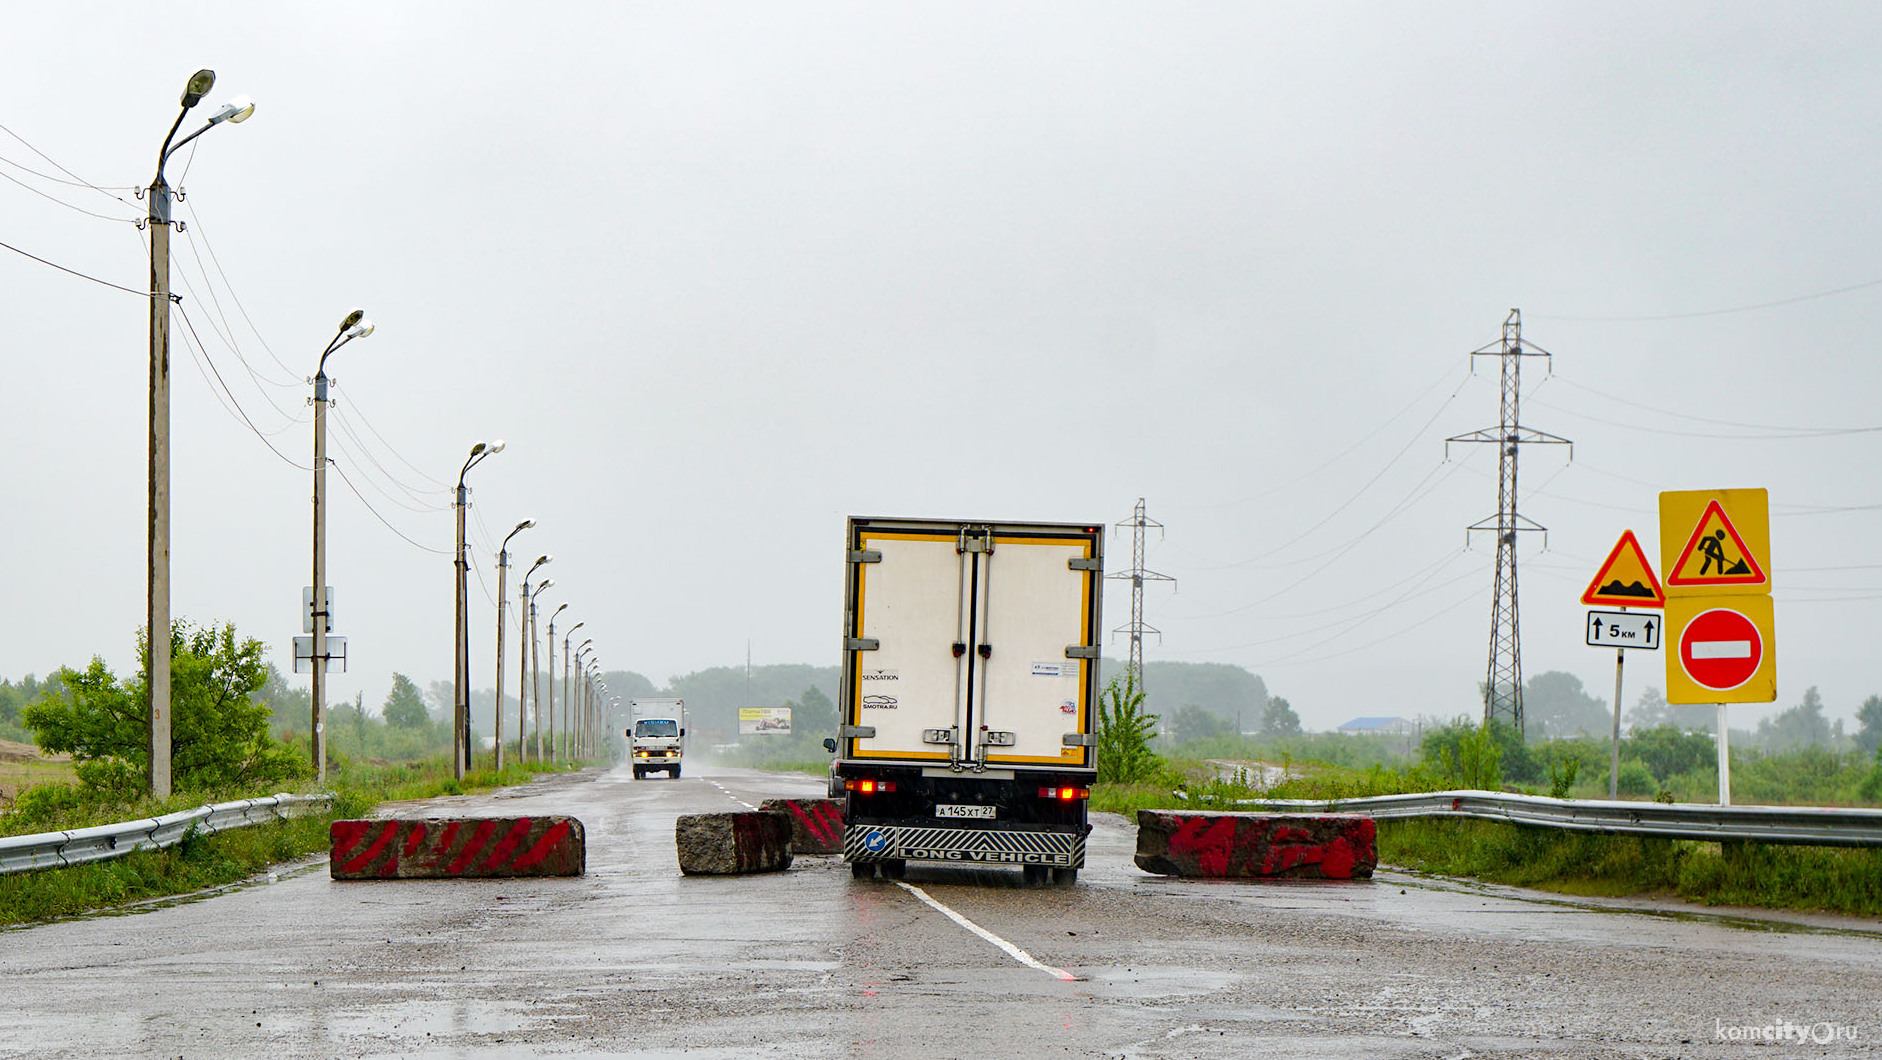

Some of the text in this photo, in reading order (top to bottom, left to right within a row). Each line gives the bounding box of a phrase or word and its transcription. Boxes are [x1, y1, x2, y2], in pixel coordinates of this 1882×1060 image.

[1609, 624, 1620, 637] 5
[900, 848, 1070, 864] LONG VEHICLE
